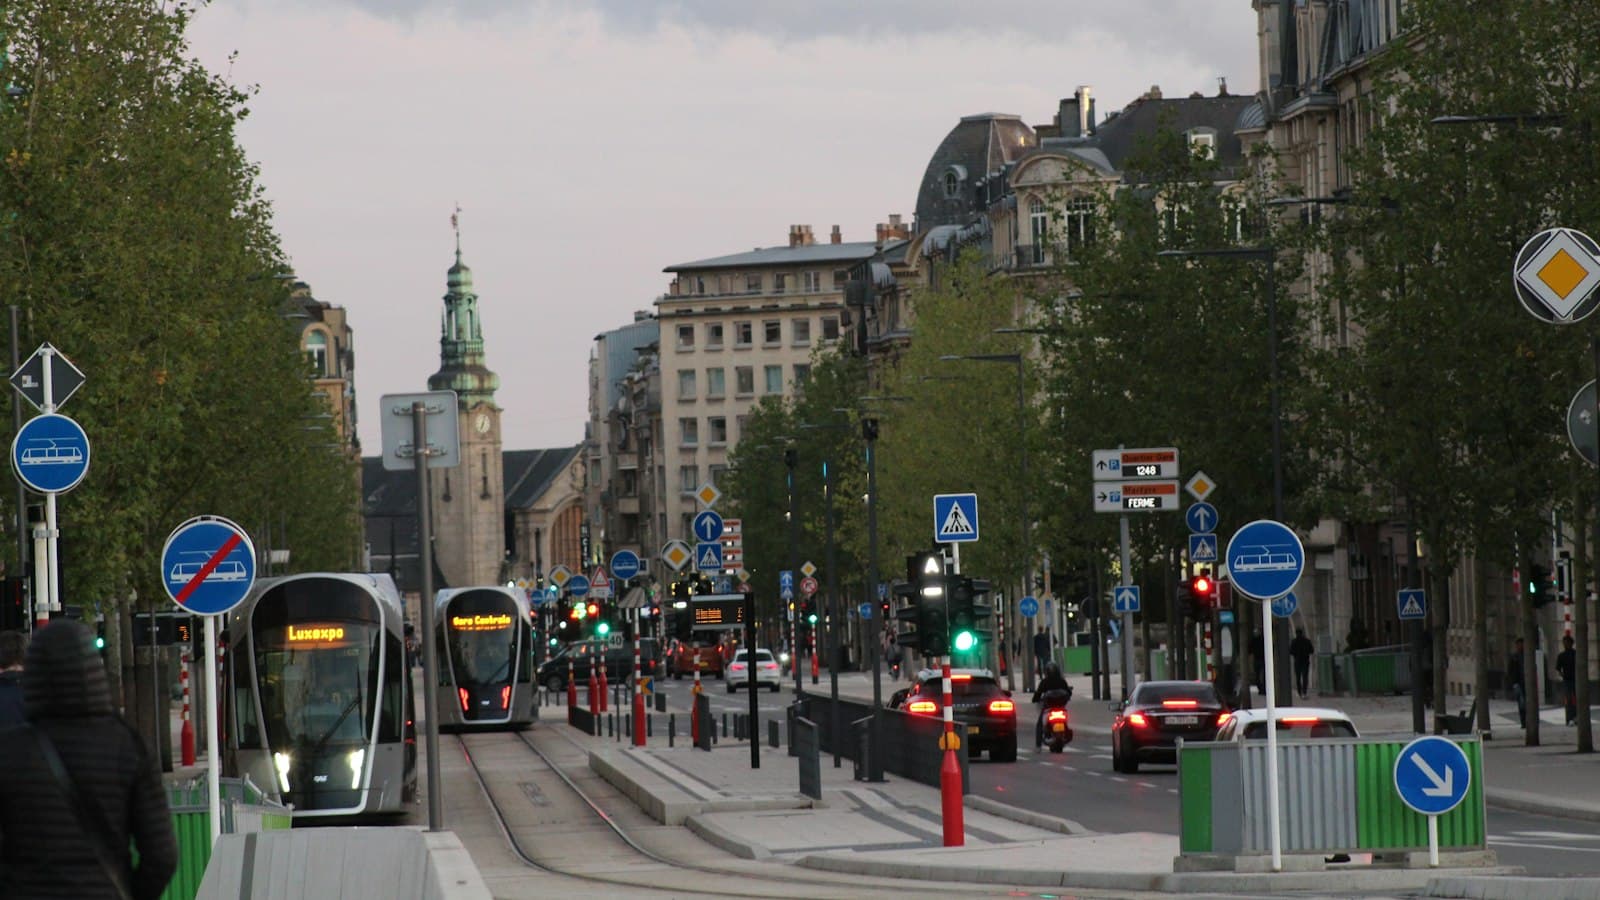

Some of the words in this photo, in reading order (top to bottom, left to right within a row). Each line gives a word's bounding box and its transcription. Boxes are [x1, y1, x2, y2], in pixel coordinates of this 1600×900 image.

[1136, 465, 1157, 476] 1248
[1128, 497, 1155, 508] FERME
[289, 625, 344, 641] Luxexpo
[609, 634, 622, 646] 40
